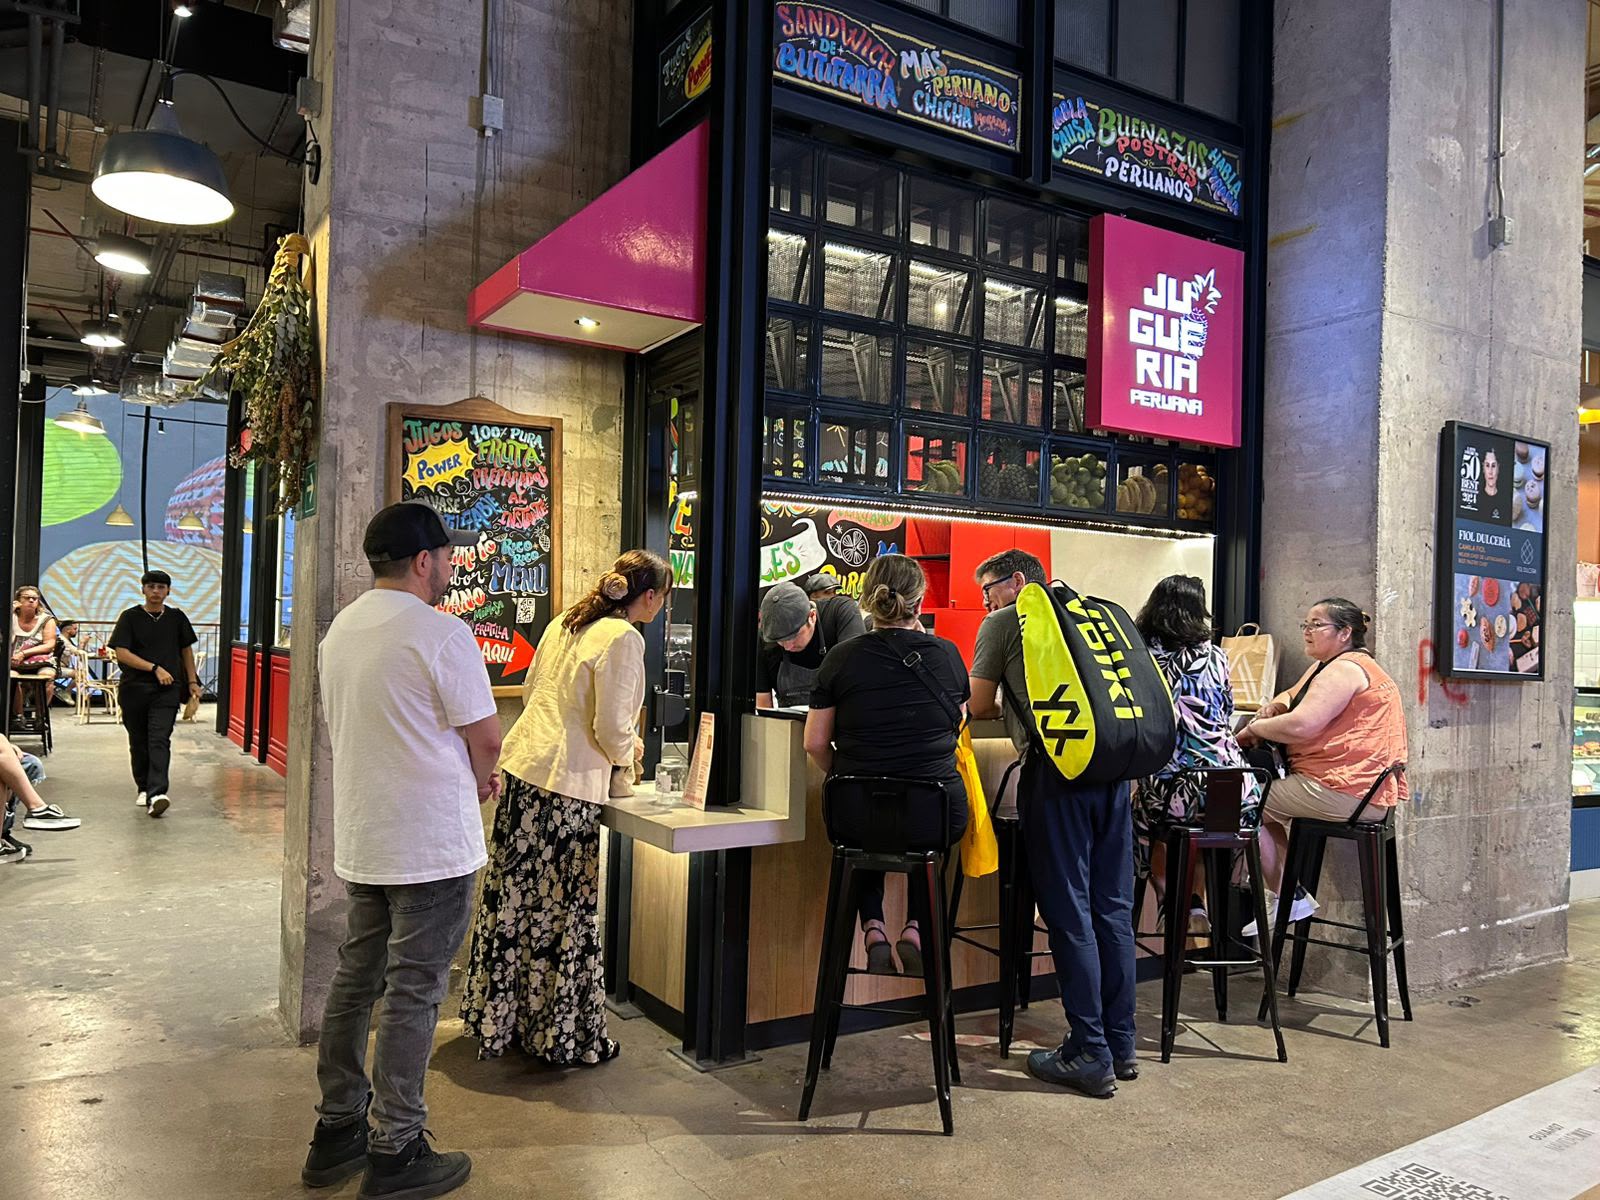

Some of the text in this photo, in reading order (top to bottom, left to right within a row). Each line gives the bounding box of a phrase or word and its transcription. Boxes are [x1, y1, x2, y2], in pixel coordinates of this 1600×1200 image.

[777, 5, 896, 77] SANDWICH
[820, 38, 836, 55] DE
[776, 42, 898, 110] BUTIFARRA
[900, 48, 948, 82] MÁS
[912, 90, 974, 130] CHICHA
[931, 75, 1010, 113] PERUANO
[1098, 108, 1208, 181] BUENAZOS
[1116, 136, 1198, 188] POSTRES
[1105, 156, 1194, 203] PERUANOS
[1130, 388, 1204, 416] PERUANA
[403, 419, 463, 453] JUGOS
[510, 427, 545, 450] PURA
[417, 453, 463, 480] POWER
[476, 437, 543, 470] FRUTA
[1460, 455, 1481, 481] 50
[1458, 529, 1476, 542] FIOL
[482, 641, 517, 664] AQUÍ
